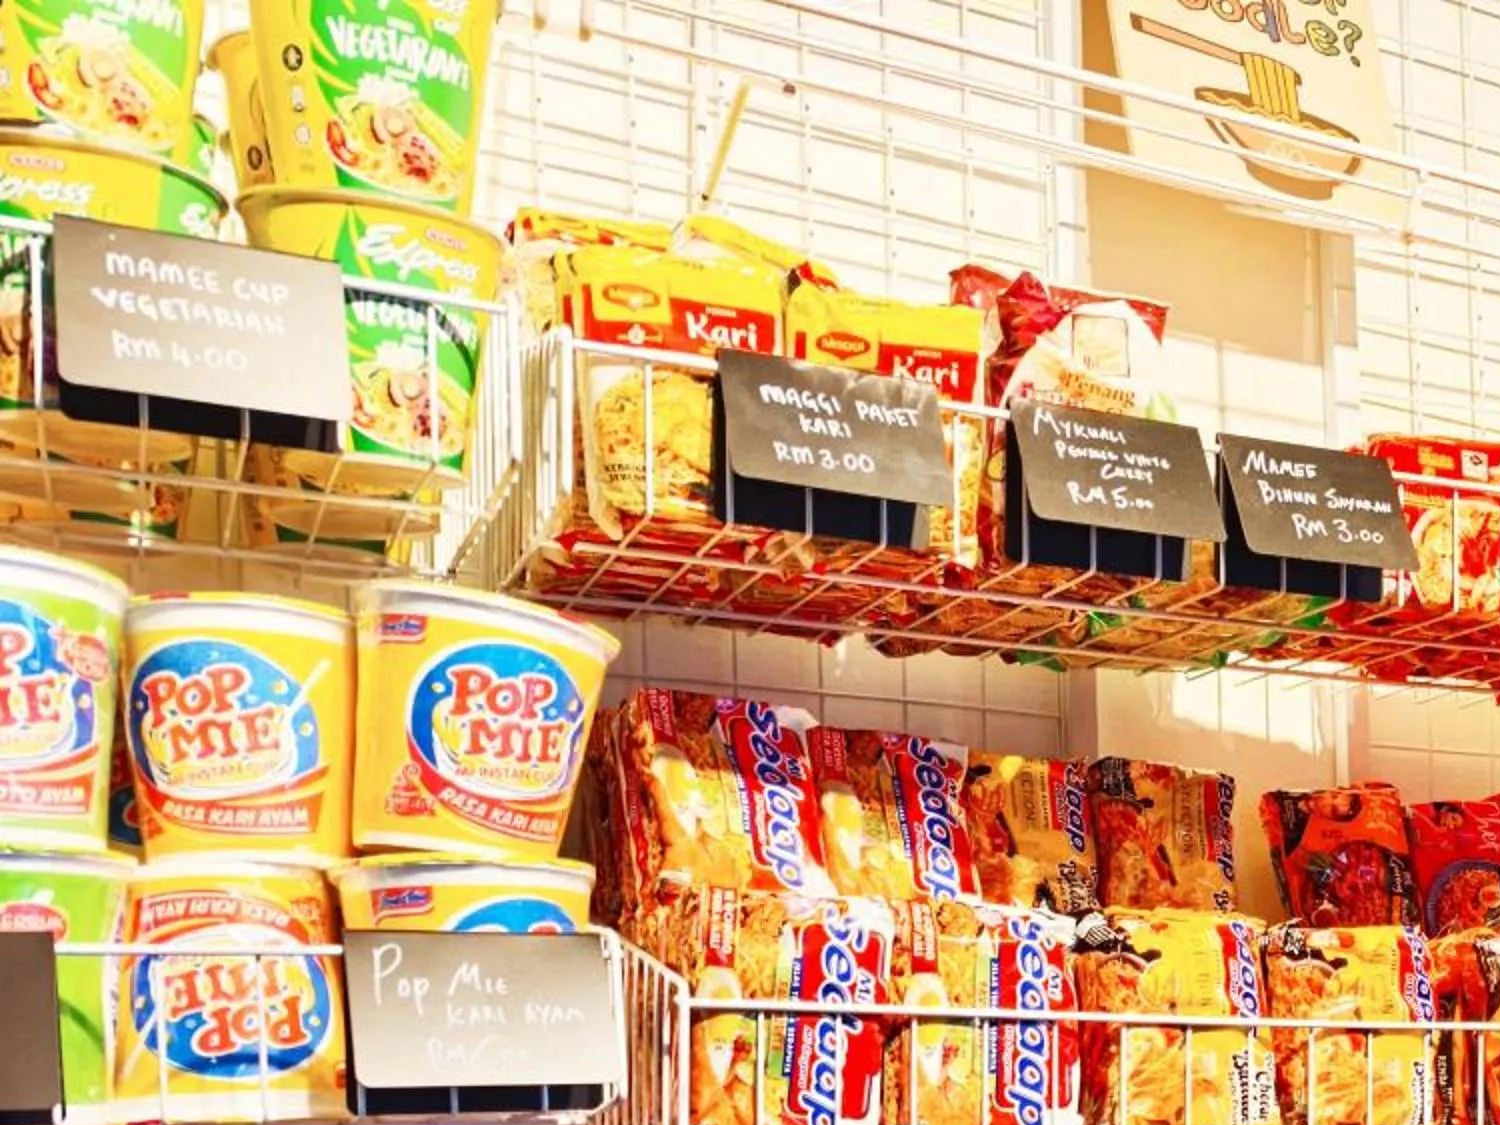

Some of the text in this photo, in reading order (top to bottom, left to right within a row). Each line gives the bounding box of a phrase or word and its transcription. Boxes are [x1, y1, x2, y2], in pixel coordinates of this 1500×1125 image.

[106, 251, 289, 304] MAMEE CUP
[91, 287, 285, 335] VEGETARIAN
[113, 330, 161, 362] RM
[685, 312, 758, 350] Kari
[892, 356, 960, 388] Kari
[760, 384, 919, 427] MAGGI PAKET
[800, 415, 852, 438] KARI
[773, 442, 875, 473] RM 3.00
[1243, 450, 1317, 478] MAMEE
[1257, 480, 1317, 504] BIHUN
[1292, 514, 1385, 543] RM 3.00
[142, 665, 246, 728] POP
[449, 667, 554, 719] POP
[170, 706, 281, 763] MIE
[464, 718, 565, 763] MIE
[438, 785, 487, 817] RASA
